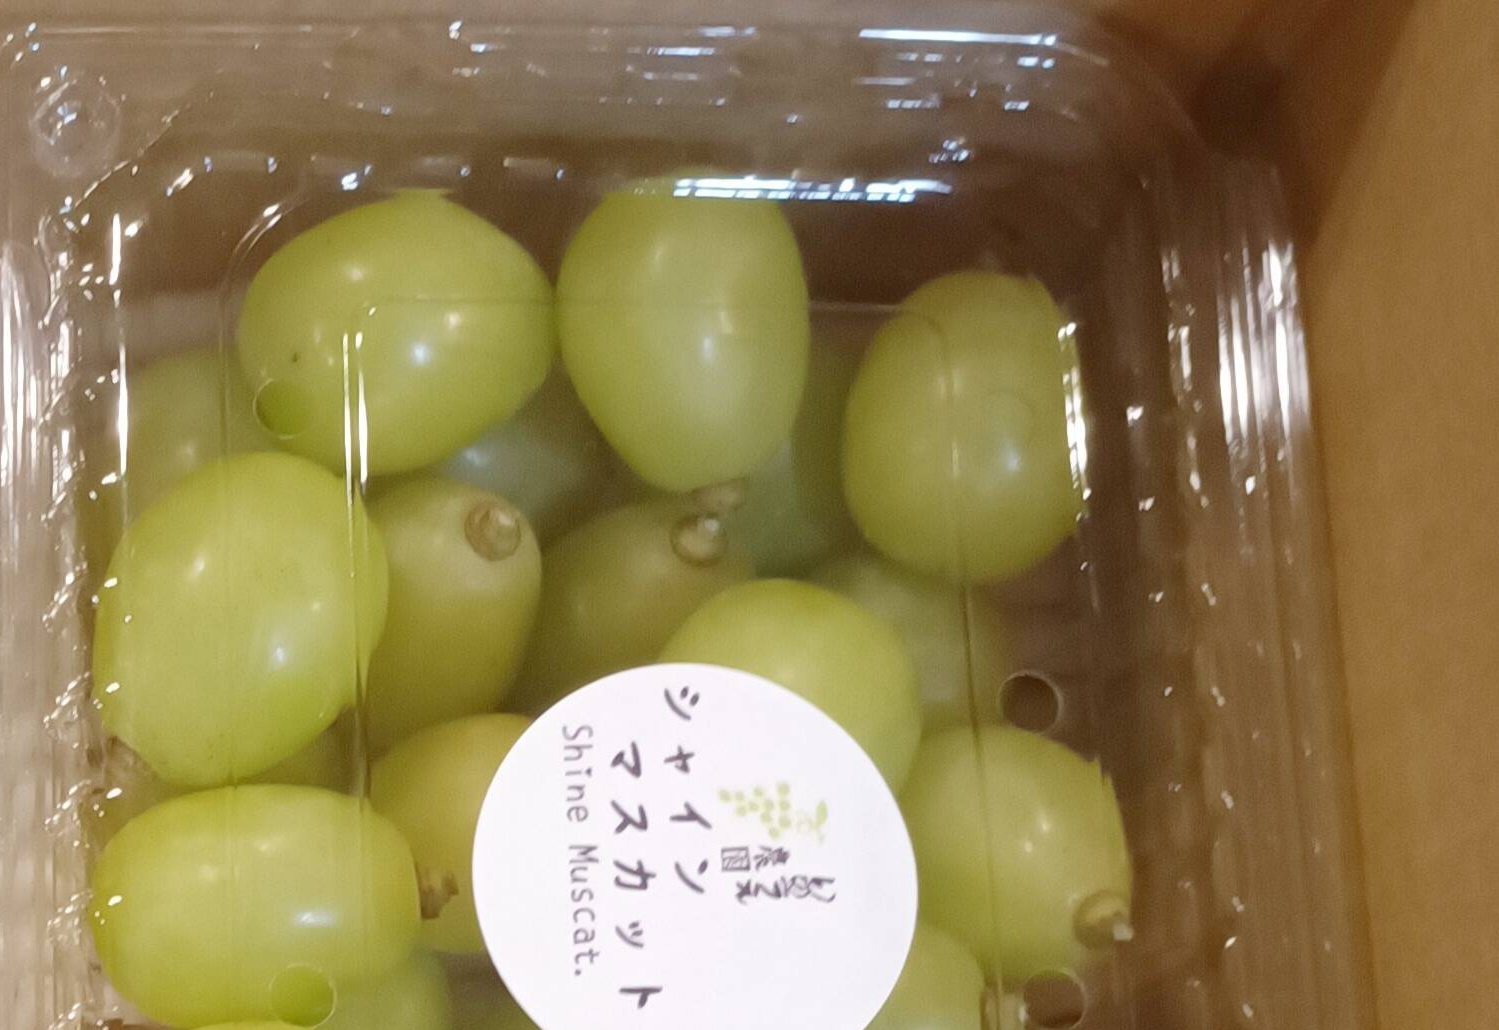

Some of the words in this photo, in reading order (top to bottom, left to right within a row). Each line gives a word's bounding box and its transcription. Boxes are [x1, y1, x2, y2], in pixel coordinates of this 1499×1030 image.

[562, 724, 594, 823] Shine
[663, 686, 713, 894] シャイン
[568, 844, 600, 977] Muscat.
[610, 741, 664, 1009] マスカット
